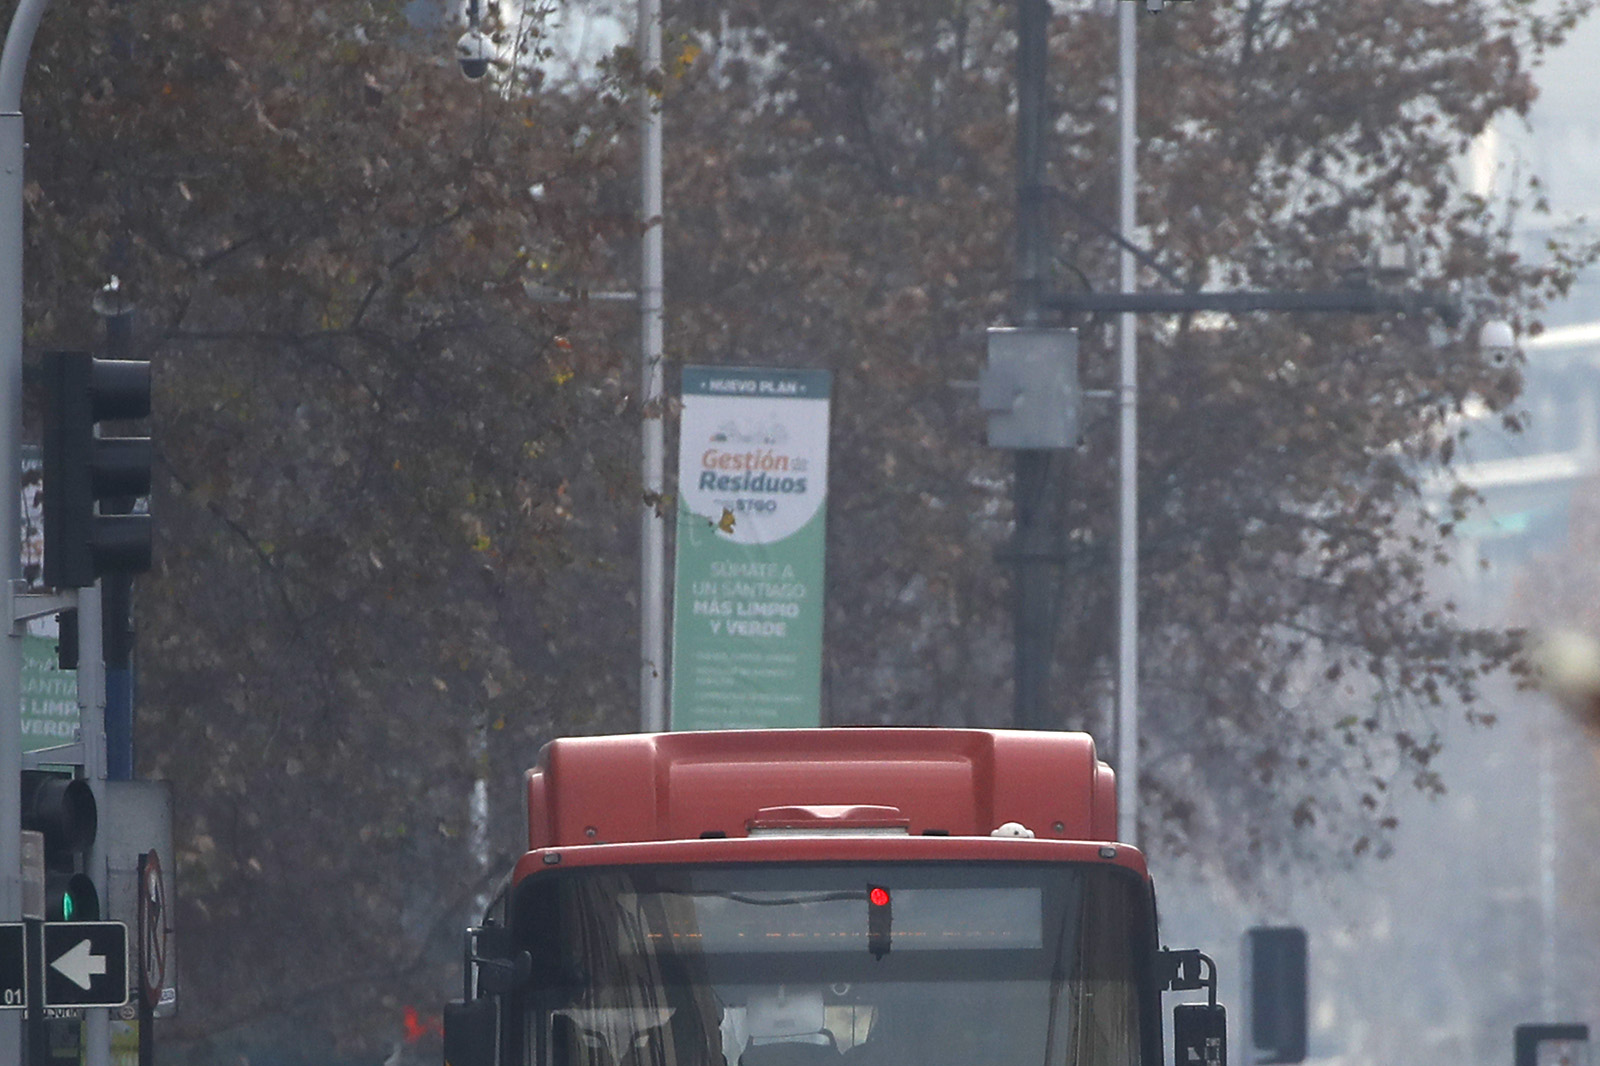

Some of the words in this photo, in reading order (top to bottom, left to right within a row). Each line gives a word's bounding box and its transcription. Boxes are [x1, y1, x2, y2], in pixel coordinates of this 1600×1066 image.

[709, 380, 758, 393] NUEVO
[759, 380, 797, 393] PLAN
[702, 448, 789, 472] Gestión
[699, 470, 808, 493] Residuos
[782, 564, 795, 578] A
[692, 581, 717, 596] UN
[693, 598, 732, 615] MÁS
[736, 602, 800, 618] LIMPIO
[710, 619, 721, 634] Y
[726, 620, 787, 638] VERDE
[32, 701, 80, 716] LIMP
[4, 988, 22, 1005] 01
